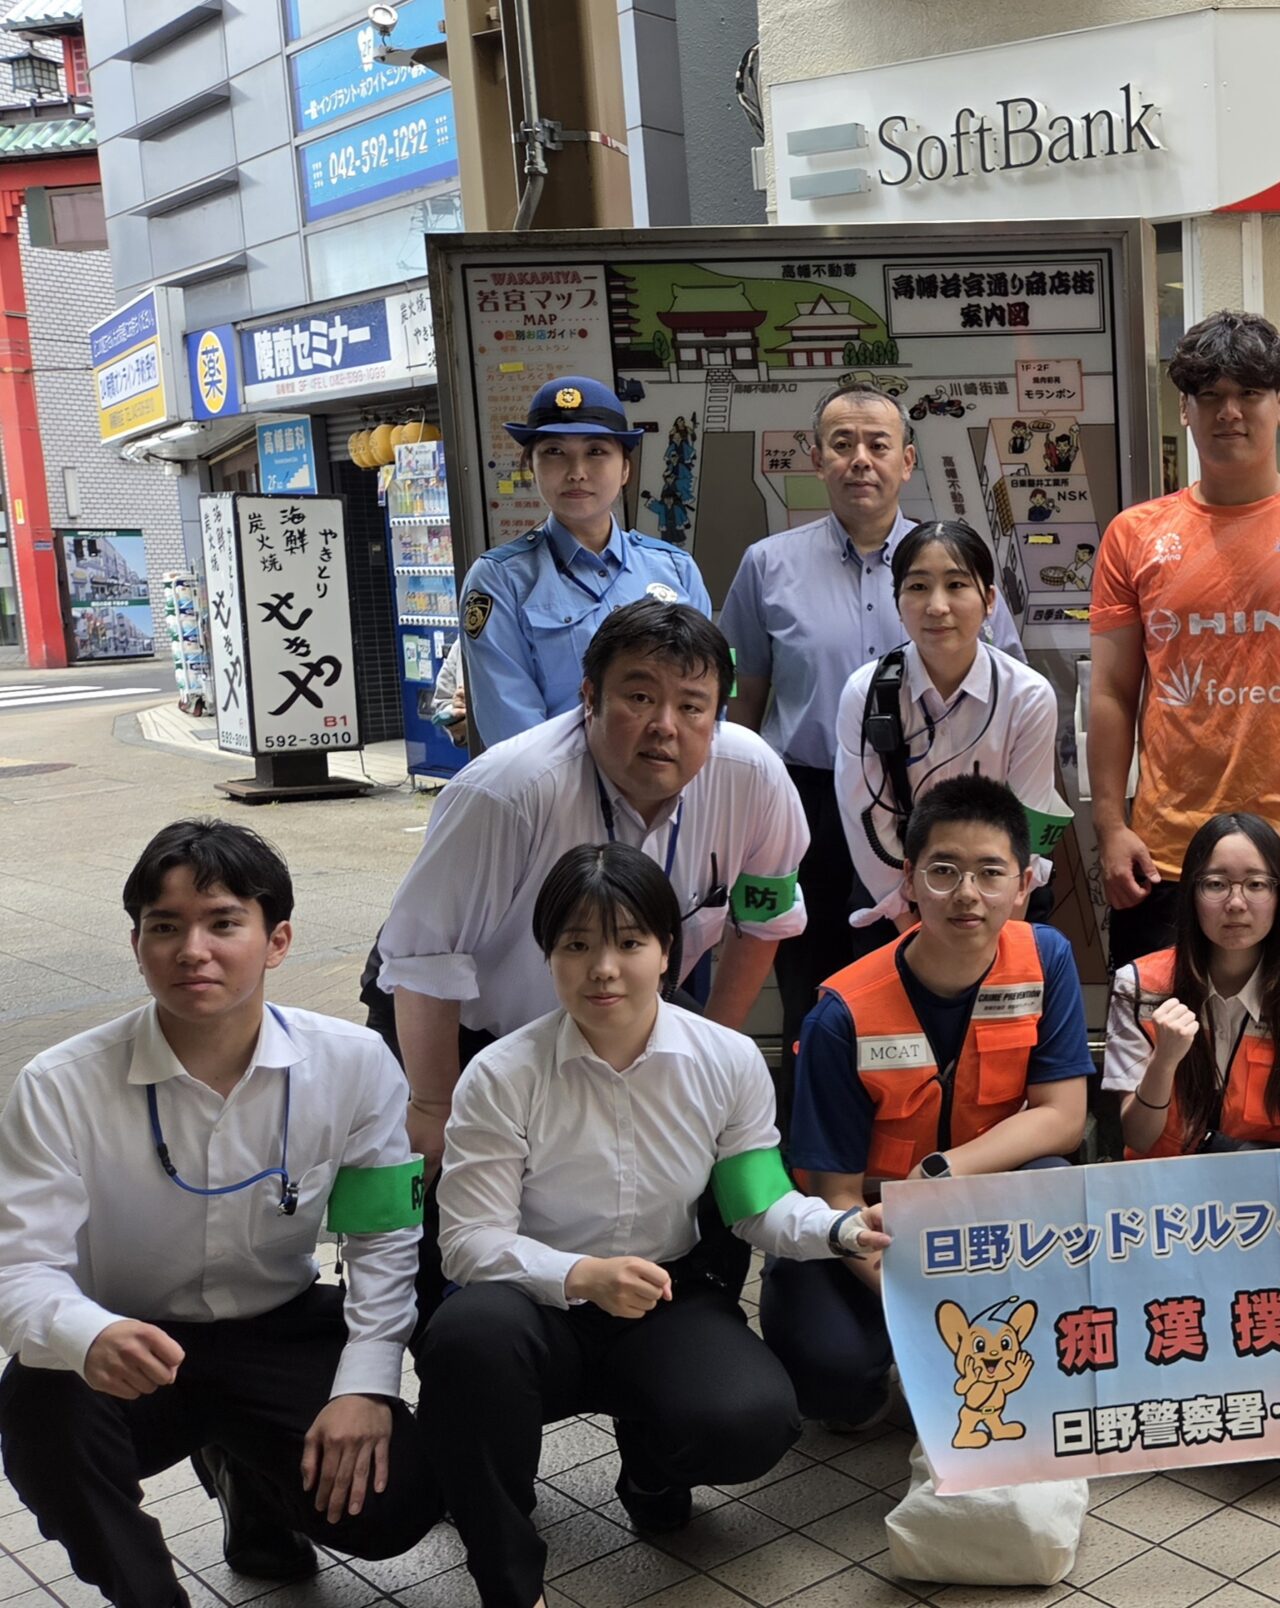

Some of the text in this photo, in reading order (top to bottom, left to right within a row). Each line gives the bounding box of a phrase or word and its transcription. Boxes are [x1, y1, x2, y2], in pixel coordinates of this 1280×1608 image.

[878, 82, 1161, 186] SoftBank
[782, 263, 857, 278] 高幡不動尊
[891, 270, 1095, 300] 高幡若宮通り商店街
[476, 288, 598, 313] 若宮マップ
[523, 314, 557, 326] MAP
[961, 302, 1030, 327] 案内図
[504, 328, 577, 341] 色別お店ガイド
[253, 314, 371, 381] 陵南セミナー
[201, 345, 224, 399] 薬
[950, 381, 1010, 397] 川崎街道
[1024, 388, 1076, 399] モランボン
[765, 449, 796, 457] スナック
[769, 458, 792, 470] 弁天
[1057, 490, 1088, 502] NSK
[280, 505, 309, 555] 海鮮
[248, 512, 283, 572] 炭火焼
[316, 528, 339, 599] やきとり
[323, 716, 348, 727] B1
[264, 731, 351, 748] 592-3010
[744, 885, 778, 912] 防
[869, 1044, 920, 1060] MCAT
